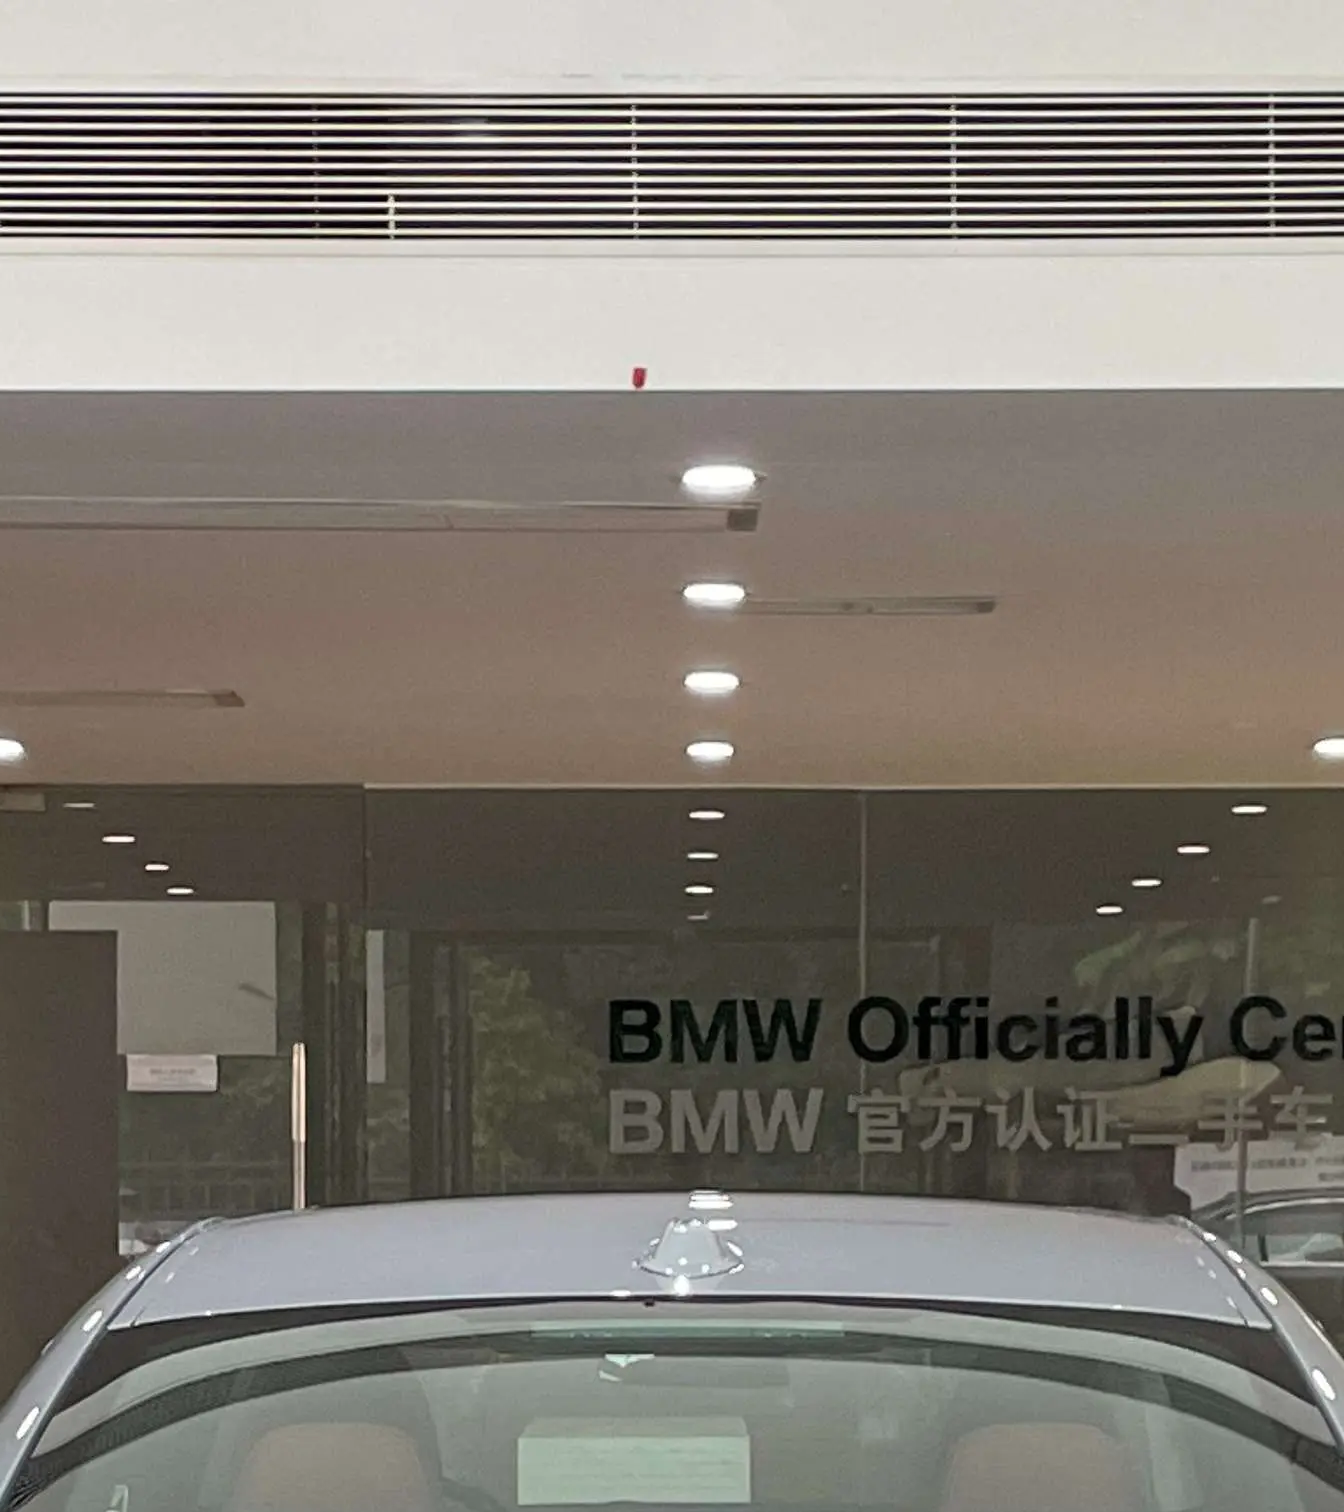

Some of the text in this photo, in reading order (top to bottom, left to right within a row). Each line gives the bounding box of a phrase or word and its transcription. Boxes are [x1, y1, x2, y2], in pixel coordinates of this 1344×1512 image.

[608, 998, 822, 1064] BMW
[846, 995, 1205, 1077] Officially
[609, 1085, 1333, 1155] BMW 官方认证二手车
